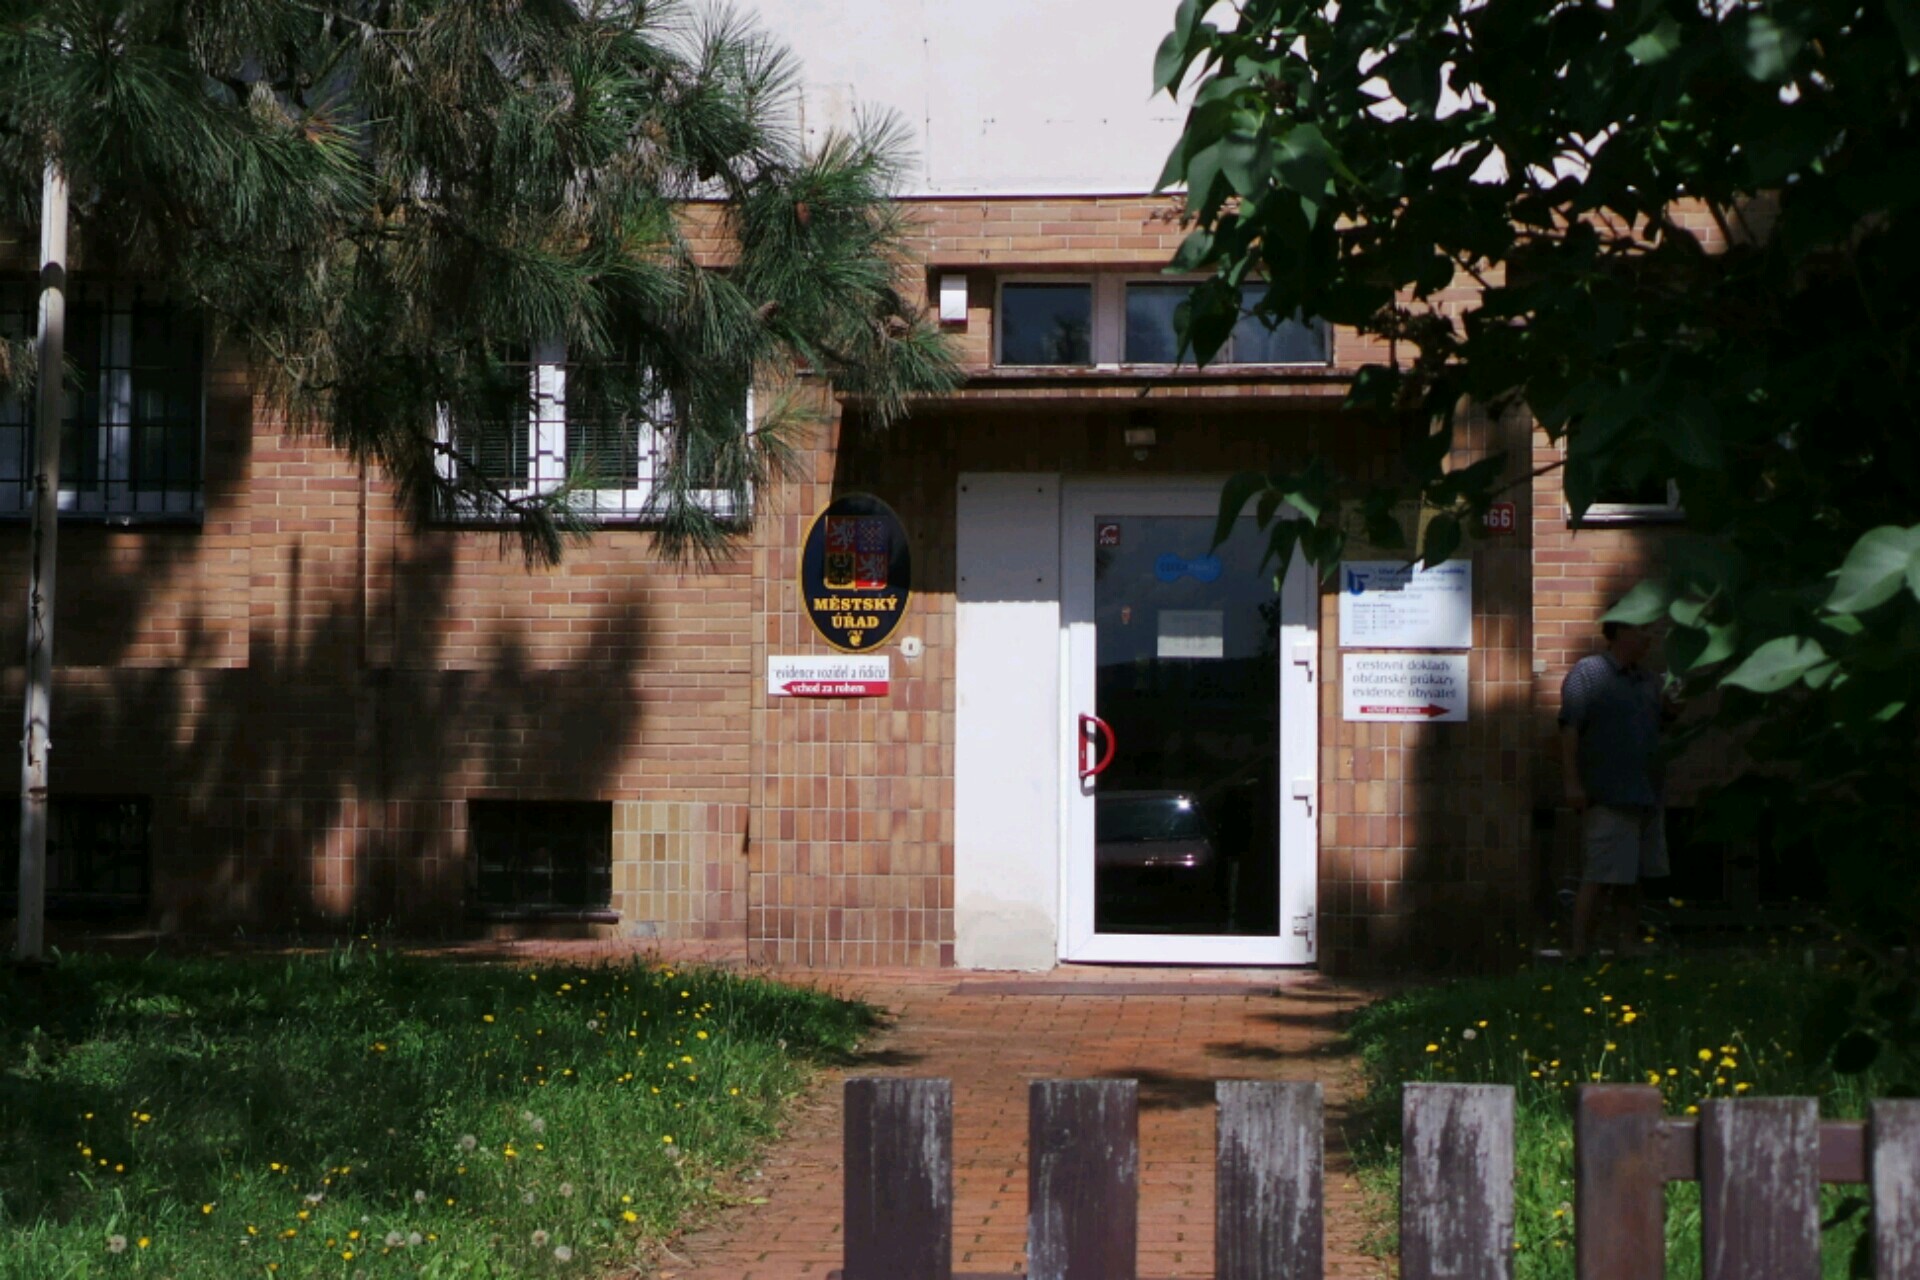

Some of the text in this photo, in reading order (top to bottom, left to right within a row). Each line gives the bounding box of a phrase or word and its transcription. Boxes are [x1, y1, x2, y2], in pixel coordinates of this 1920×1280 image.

[813, 594, 898, 611] MĚSTSKÝ
[831, 612, 880, 628] ÚŘAD
[1356, 659, 1452, 672] cestovní doklady
[1352, 672, 1454, 686] občanské průkazy
[791, 682, 866, 694] vchod za rohem
[1352, 687, 1456, 699] evidence obyvatel
